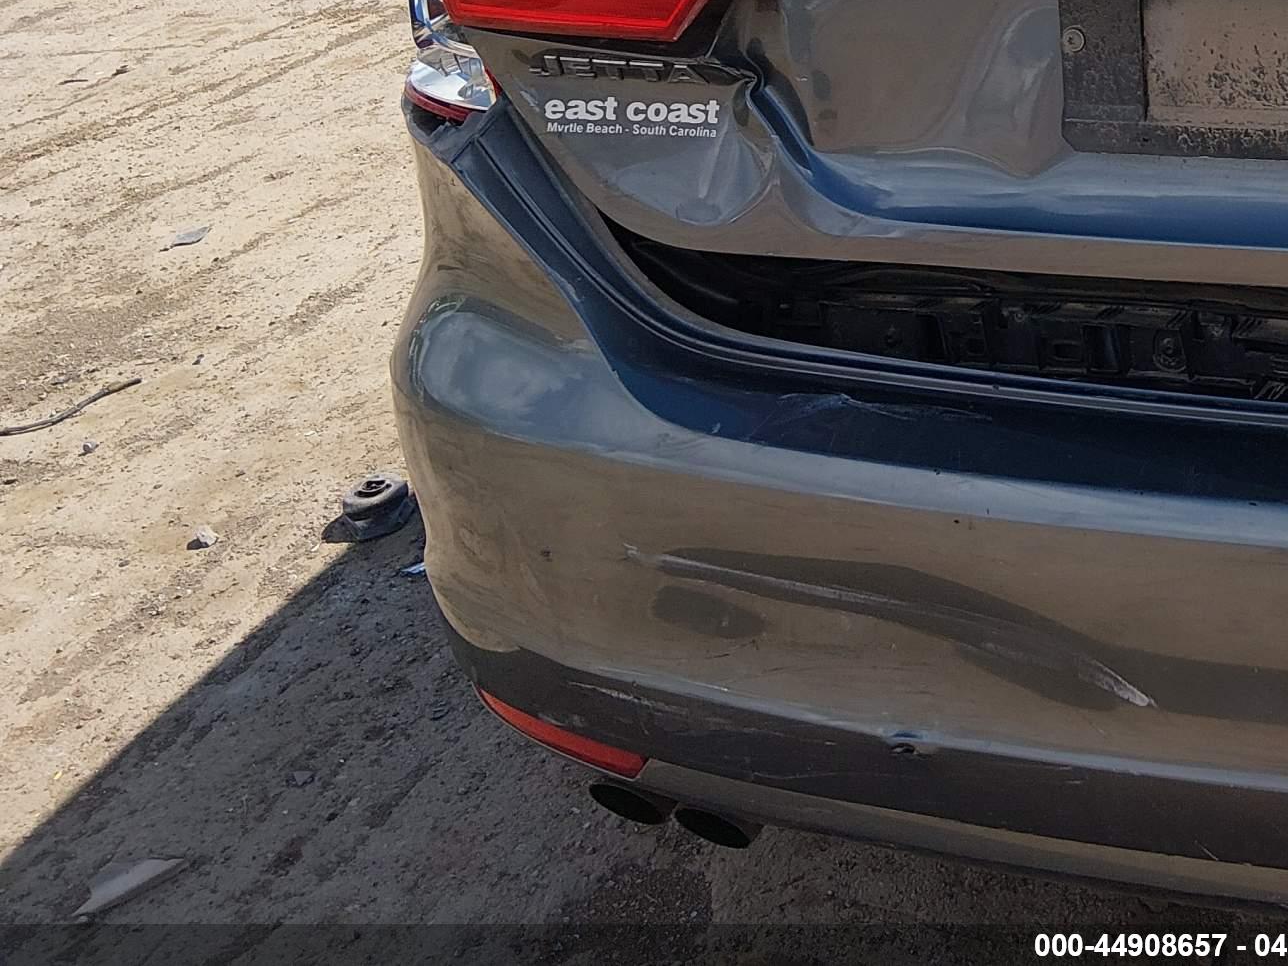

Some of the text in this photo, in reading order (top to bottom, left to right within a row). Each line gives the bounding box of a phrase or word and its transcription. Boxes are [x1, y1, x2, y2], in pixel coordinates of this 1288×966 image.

[529, 55, 710, 84] JETTA
[544, 96, 720, 124] east coast
[586, 123, 623, 134] Beach
[632, 124, 667, 135] South
[669, 125, 717, 138] Carolina
